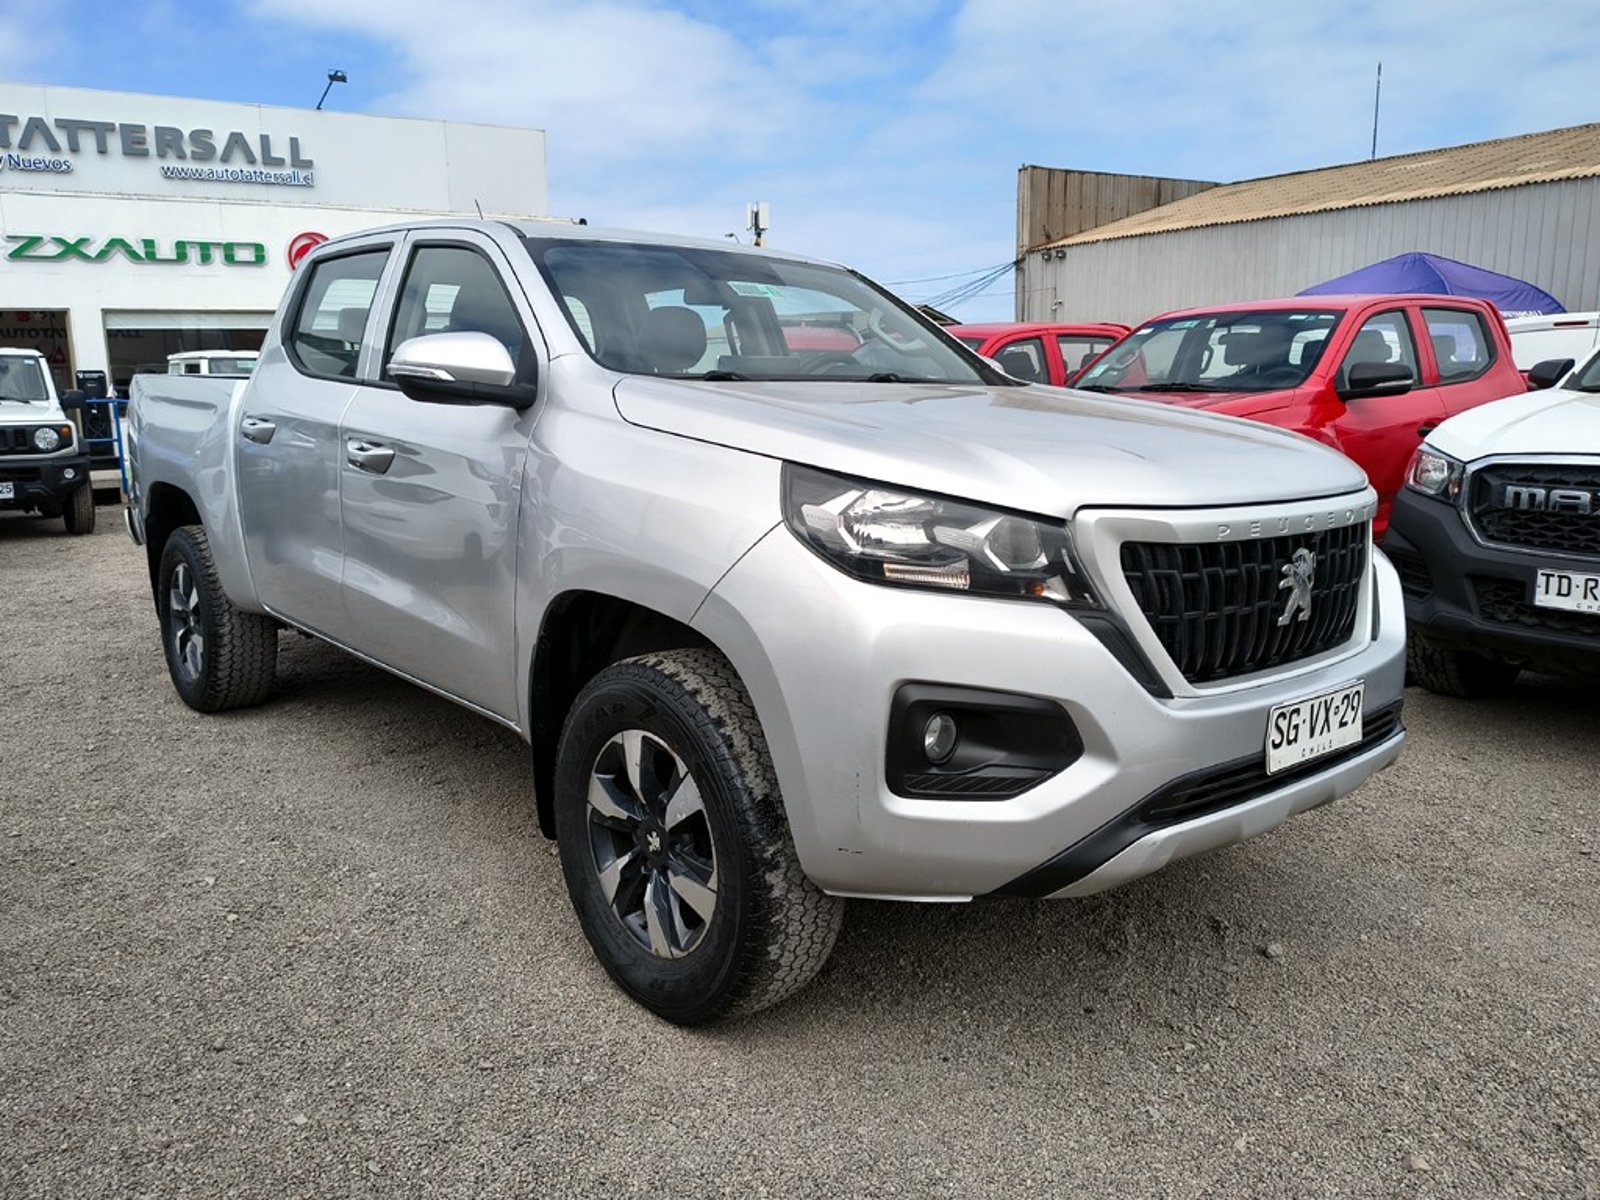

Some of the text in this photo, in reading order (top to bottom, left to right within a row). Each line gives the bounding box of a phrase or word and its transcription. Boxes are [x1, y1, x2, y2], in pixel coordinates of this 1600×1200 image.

[0, 114, 313, 168] TATTERSALL
[8, 154, 71, 170] Nuevos
[161, 165, 315, 185] www.autotattersall.cl
[5, 234, 266, 265] ZXAUTO
[0, 327, 67, 338] UTOTA
[1505, 486, 1600, 514] MA
[1217, 506, 1371, 540] PEUGEOT
